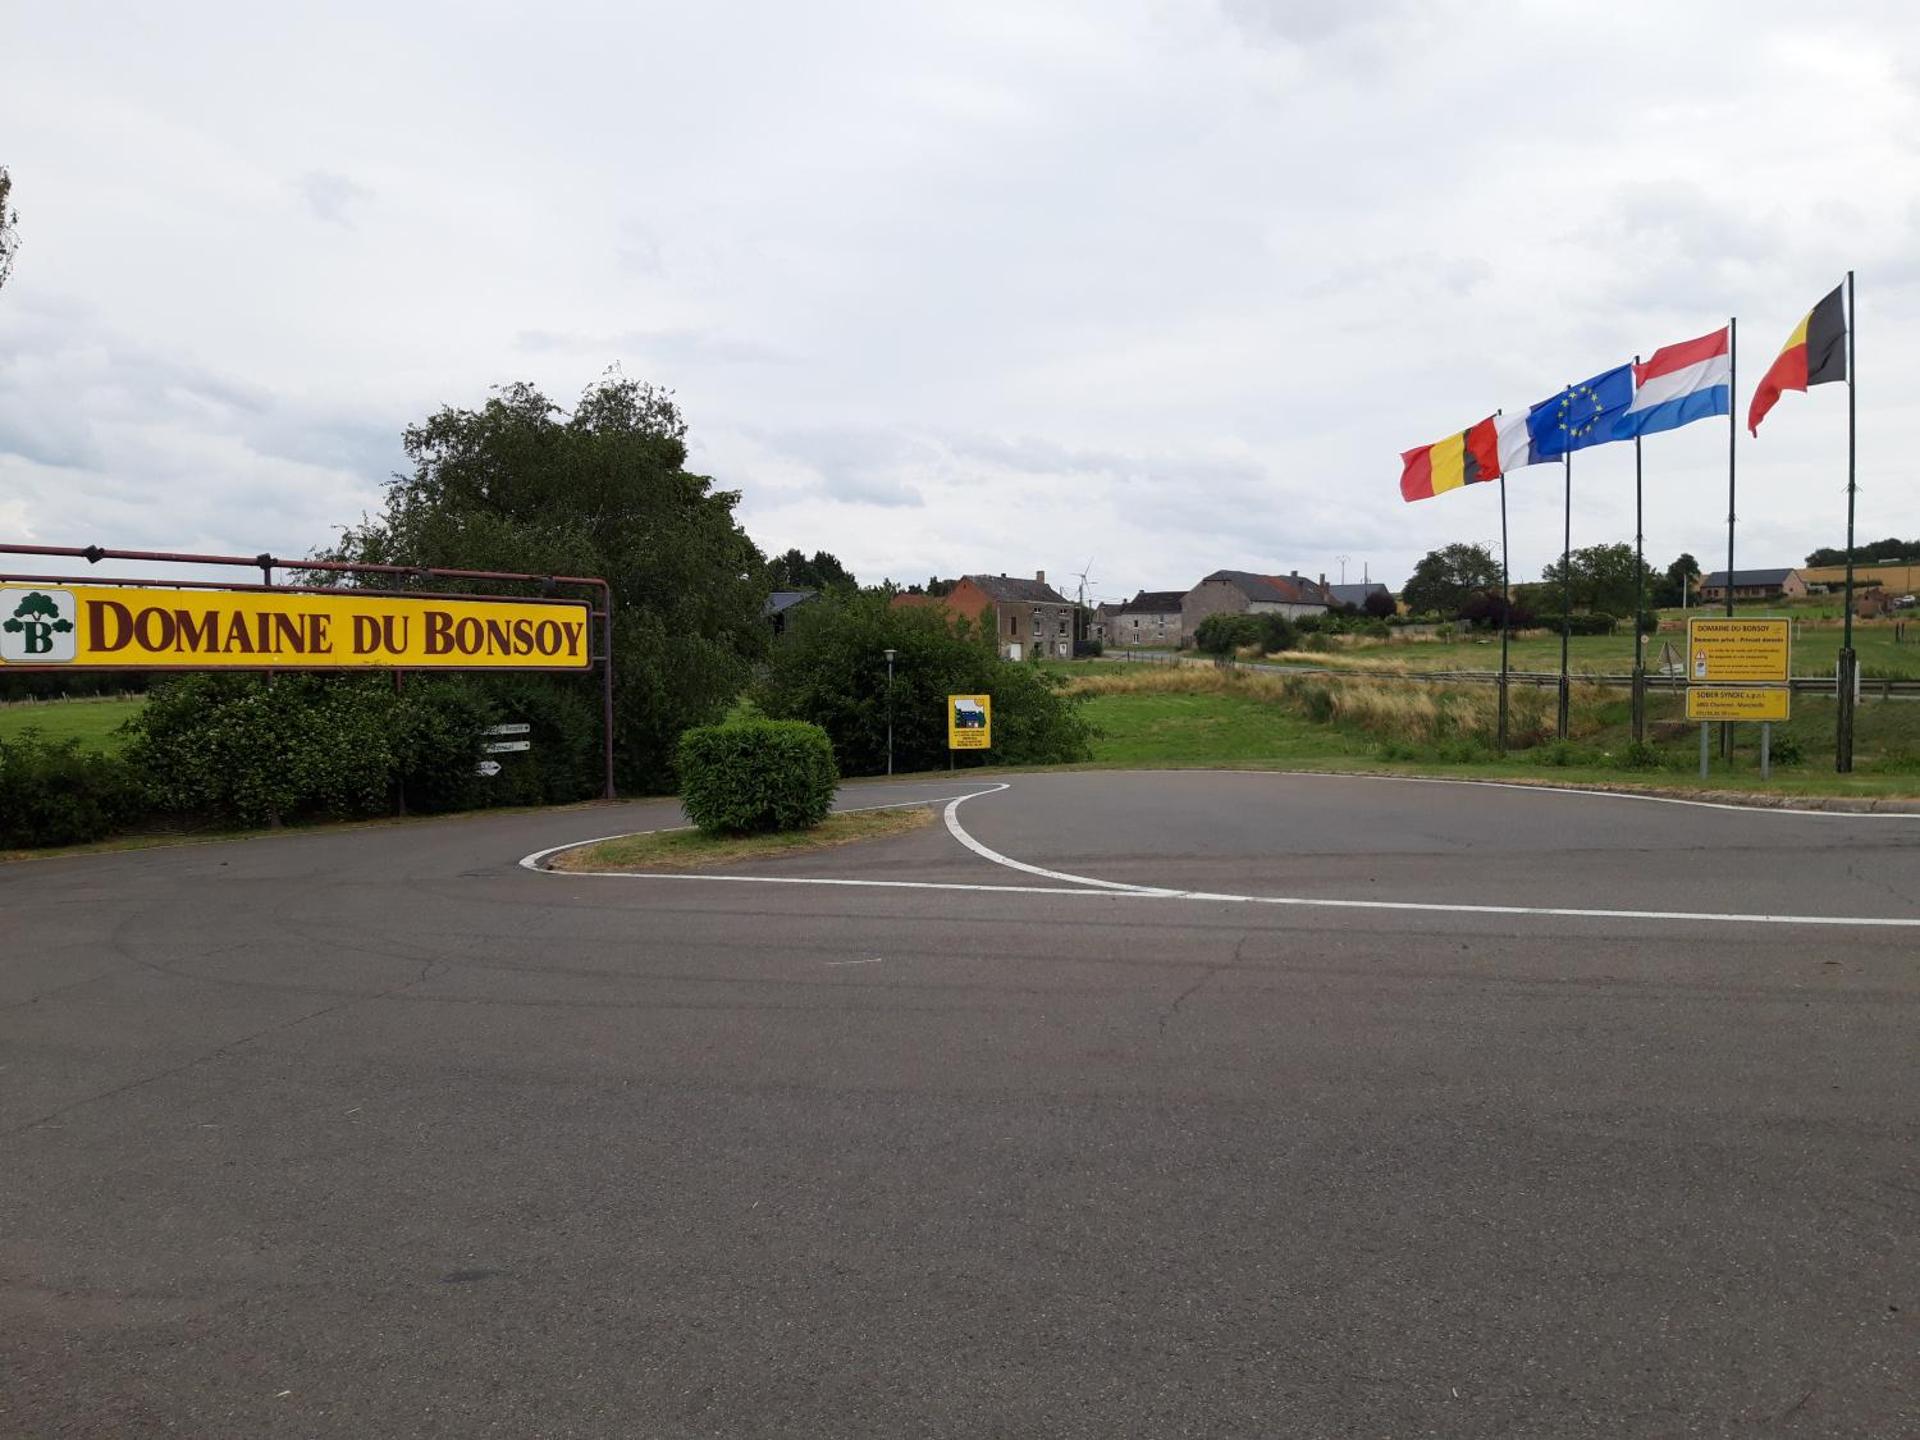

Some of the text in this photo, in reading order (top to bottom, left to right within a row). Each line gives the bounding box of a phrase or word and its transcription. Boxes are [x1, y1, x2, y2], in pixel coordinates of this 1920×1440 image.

[24, 621, 53, 654] B
[86, 600, 585, 657] DOMAINE DU BONSOY
